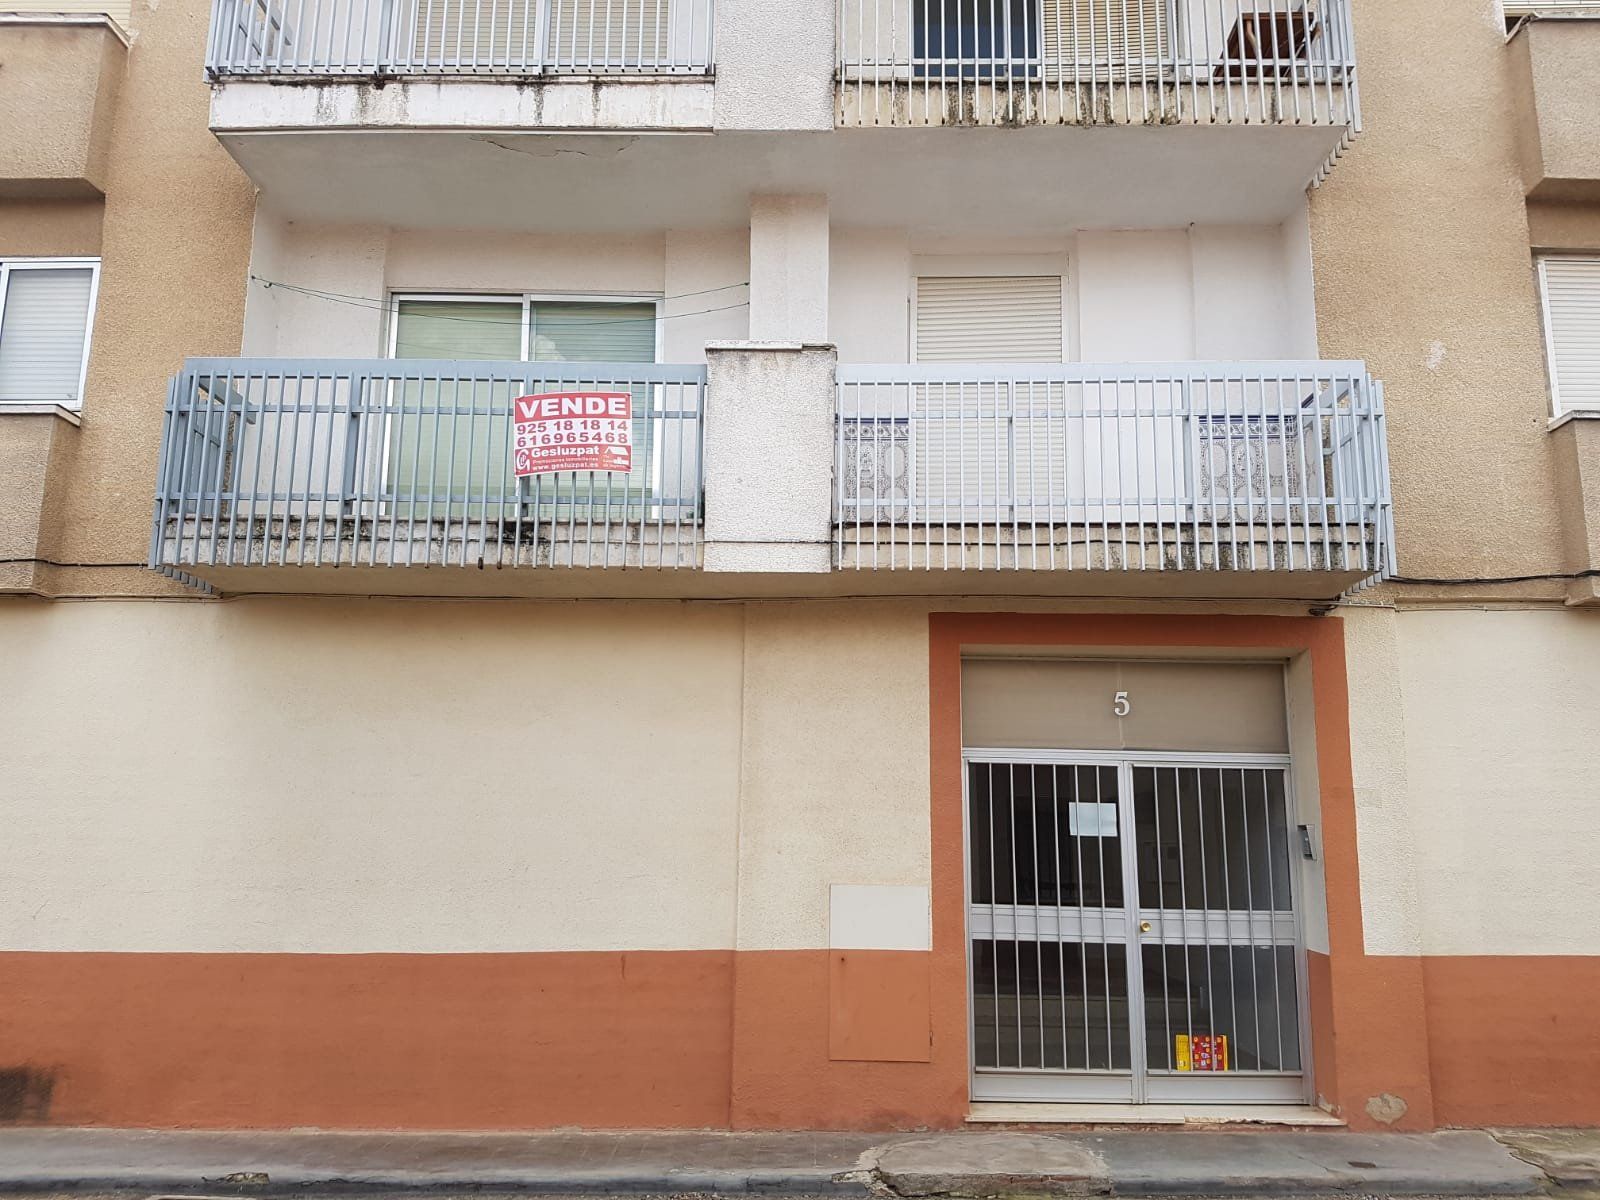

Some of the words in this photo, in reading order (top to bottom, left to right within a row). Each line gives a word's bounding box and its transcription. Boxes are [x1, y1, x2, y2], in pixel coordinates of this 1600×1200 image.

[519, 397, 627, 419] VENDE
[517, 422, 547, 435] 925
[554, 420, 573, 431] 18
[581, 420, 601, 430] 18
[608, 421, 628, 431] 14
[517, 432, 628, 447] 616965468
[531, 446, 599, 458] Gesluzpat
[1114, 691, 1130, 716] 5
